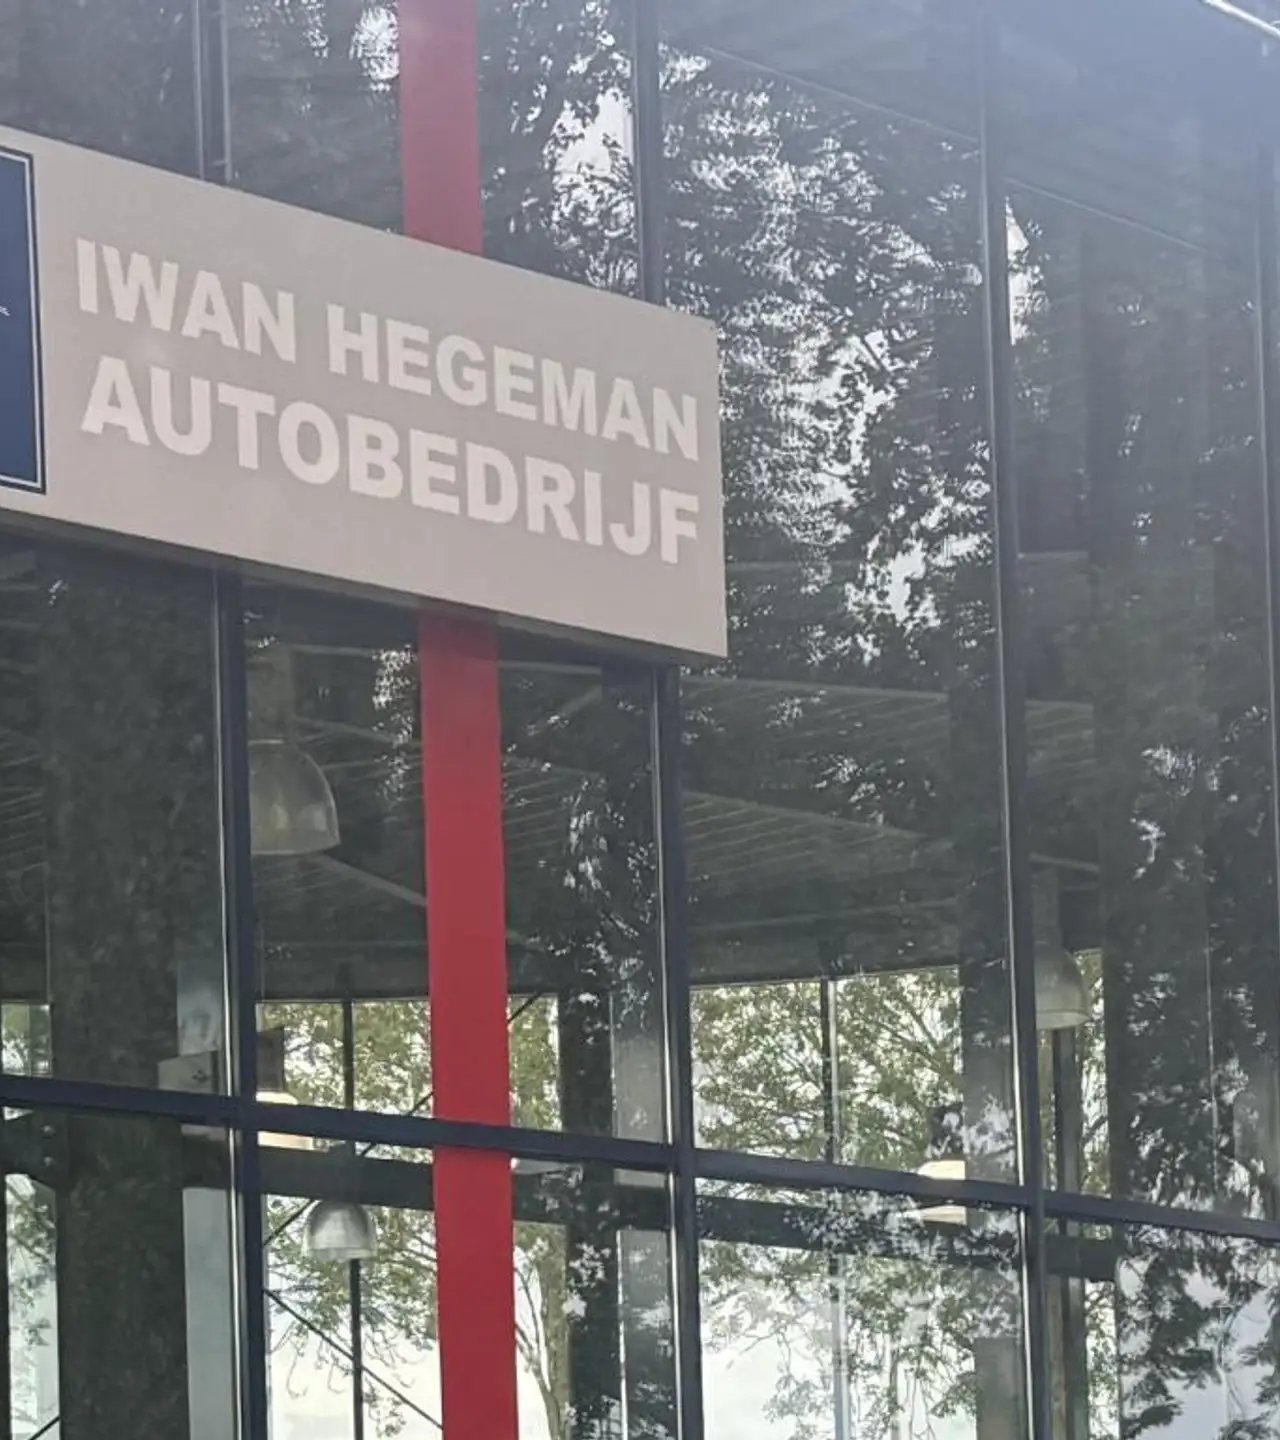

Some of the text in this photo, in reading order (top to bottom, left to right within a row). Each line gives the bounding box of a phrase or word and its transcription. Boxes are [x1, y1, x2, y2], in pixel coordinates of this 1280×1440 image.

[75, 237, 699, 461] IWAN HEGEMAN
[81, 357, 699, 565] AUTOBEDRIJF
